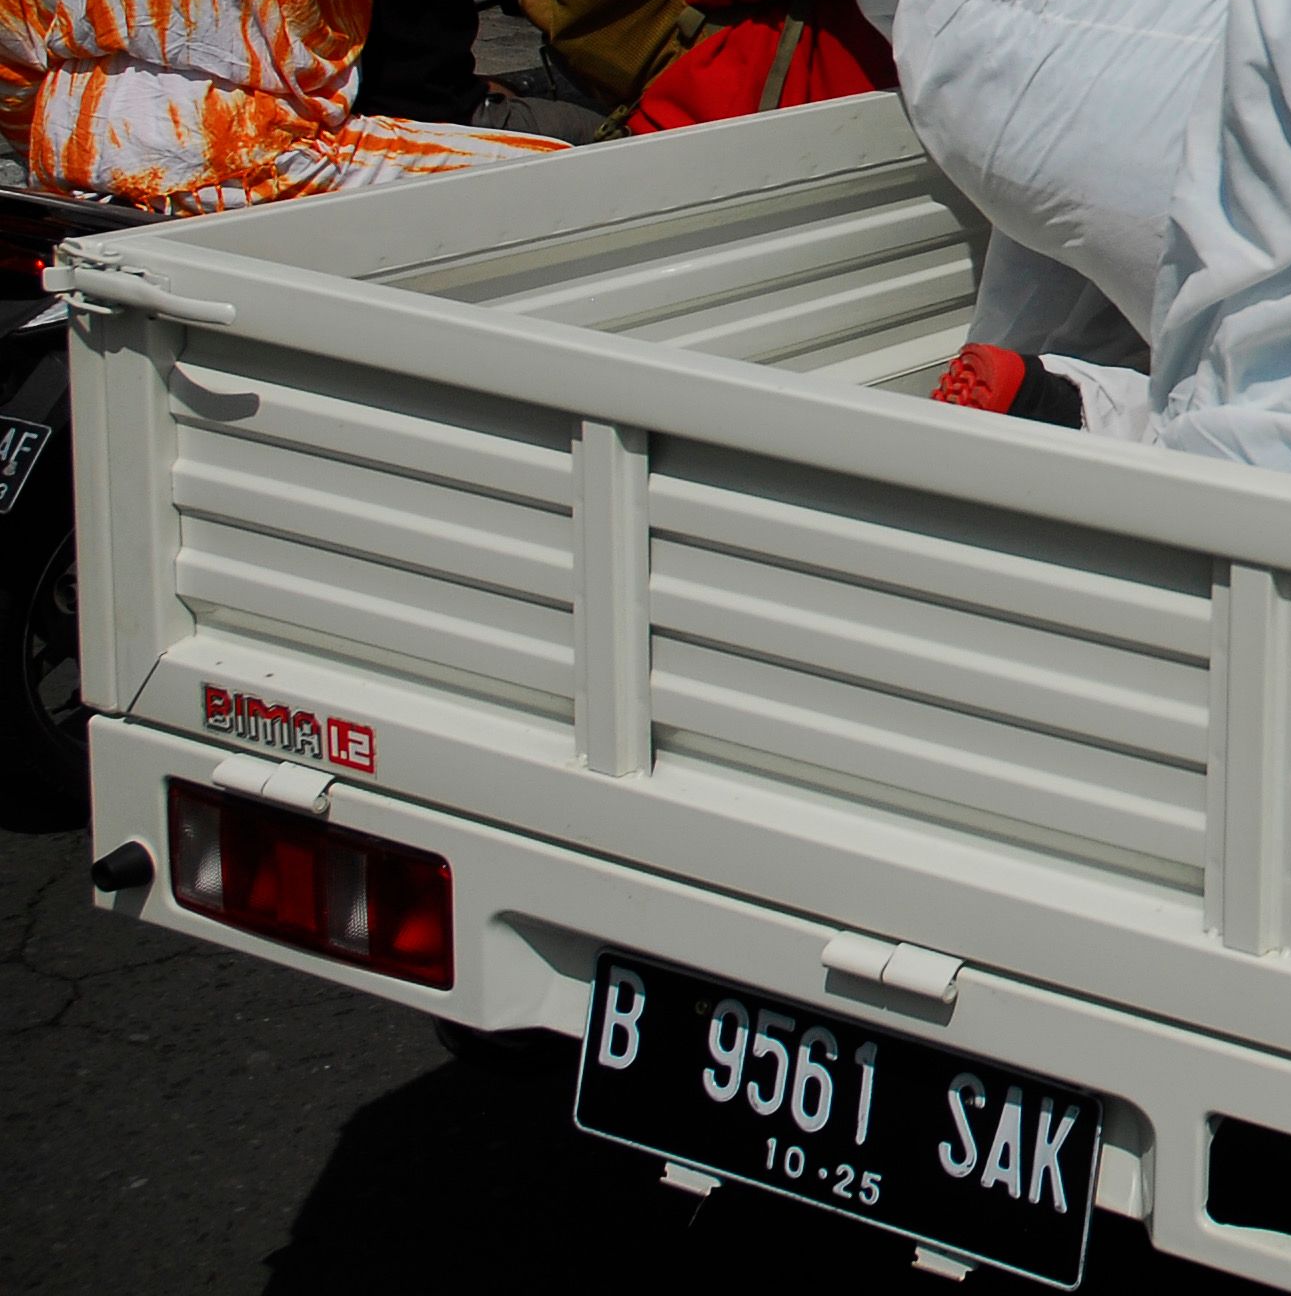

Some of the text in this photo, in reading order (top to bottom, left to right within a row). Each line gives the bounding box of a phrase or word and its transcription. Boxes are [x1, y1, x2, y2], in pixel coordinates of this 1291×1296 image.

[202, 683, 373, 768] BIMA 1.2
[597, 965, 1080, 1215] B 9561 SAK
